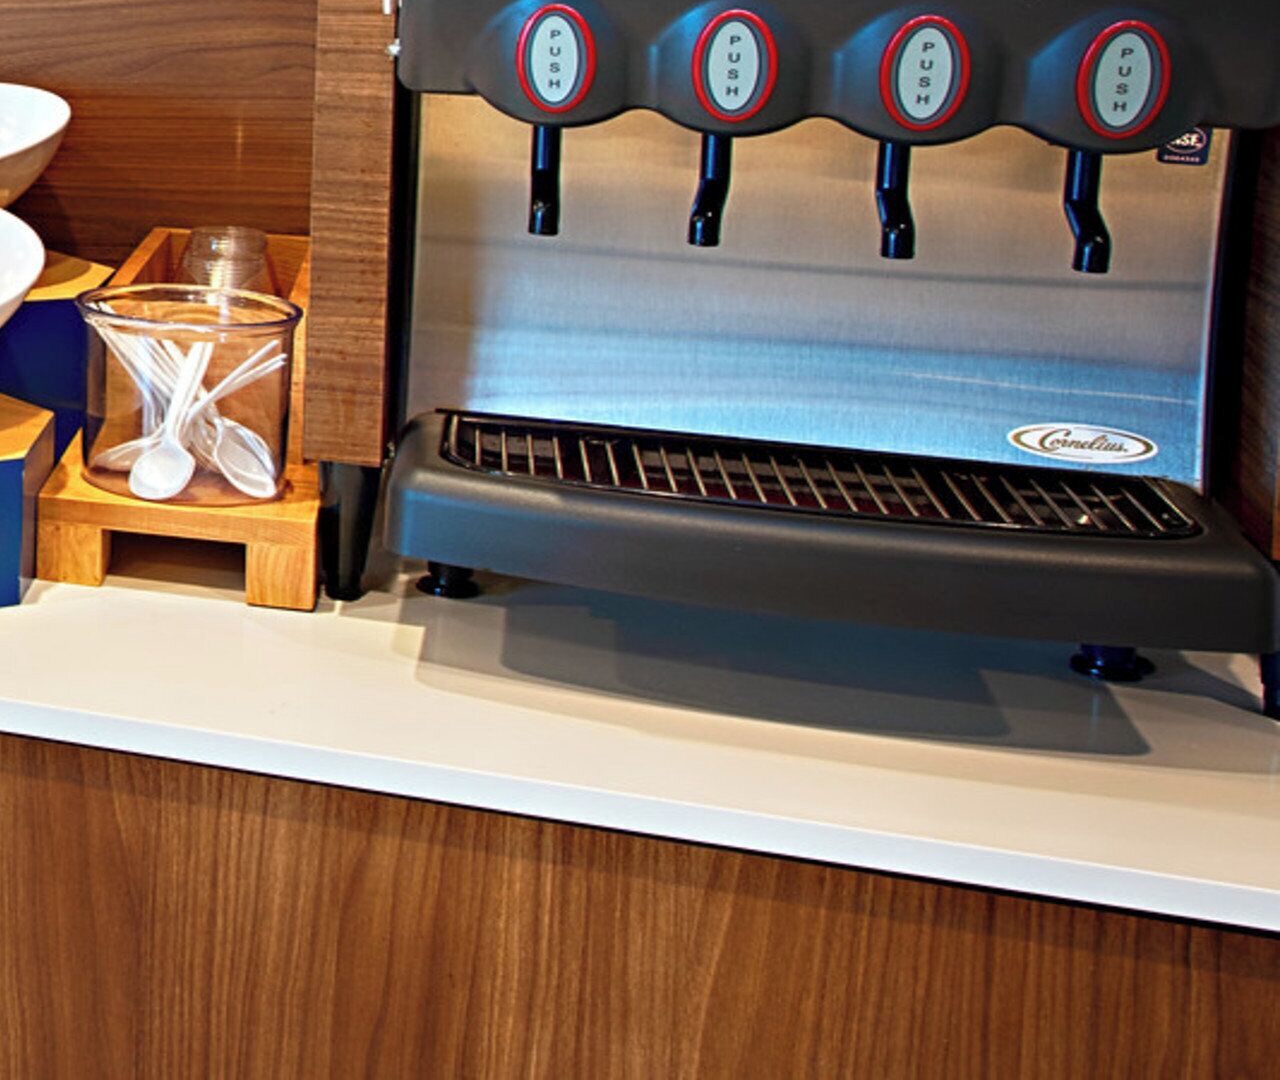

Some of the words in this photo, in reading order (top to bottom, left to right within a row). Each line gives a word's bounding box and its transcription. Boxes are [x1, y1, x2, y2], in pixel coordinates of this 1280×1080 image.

[548, 29, 562, 90] PUSH
[725, 35, 741, 97] PUSH
[916, 41, 935, 106] PUSH
[1112, 47, 1135, 113] PUSH
